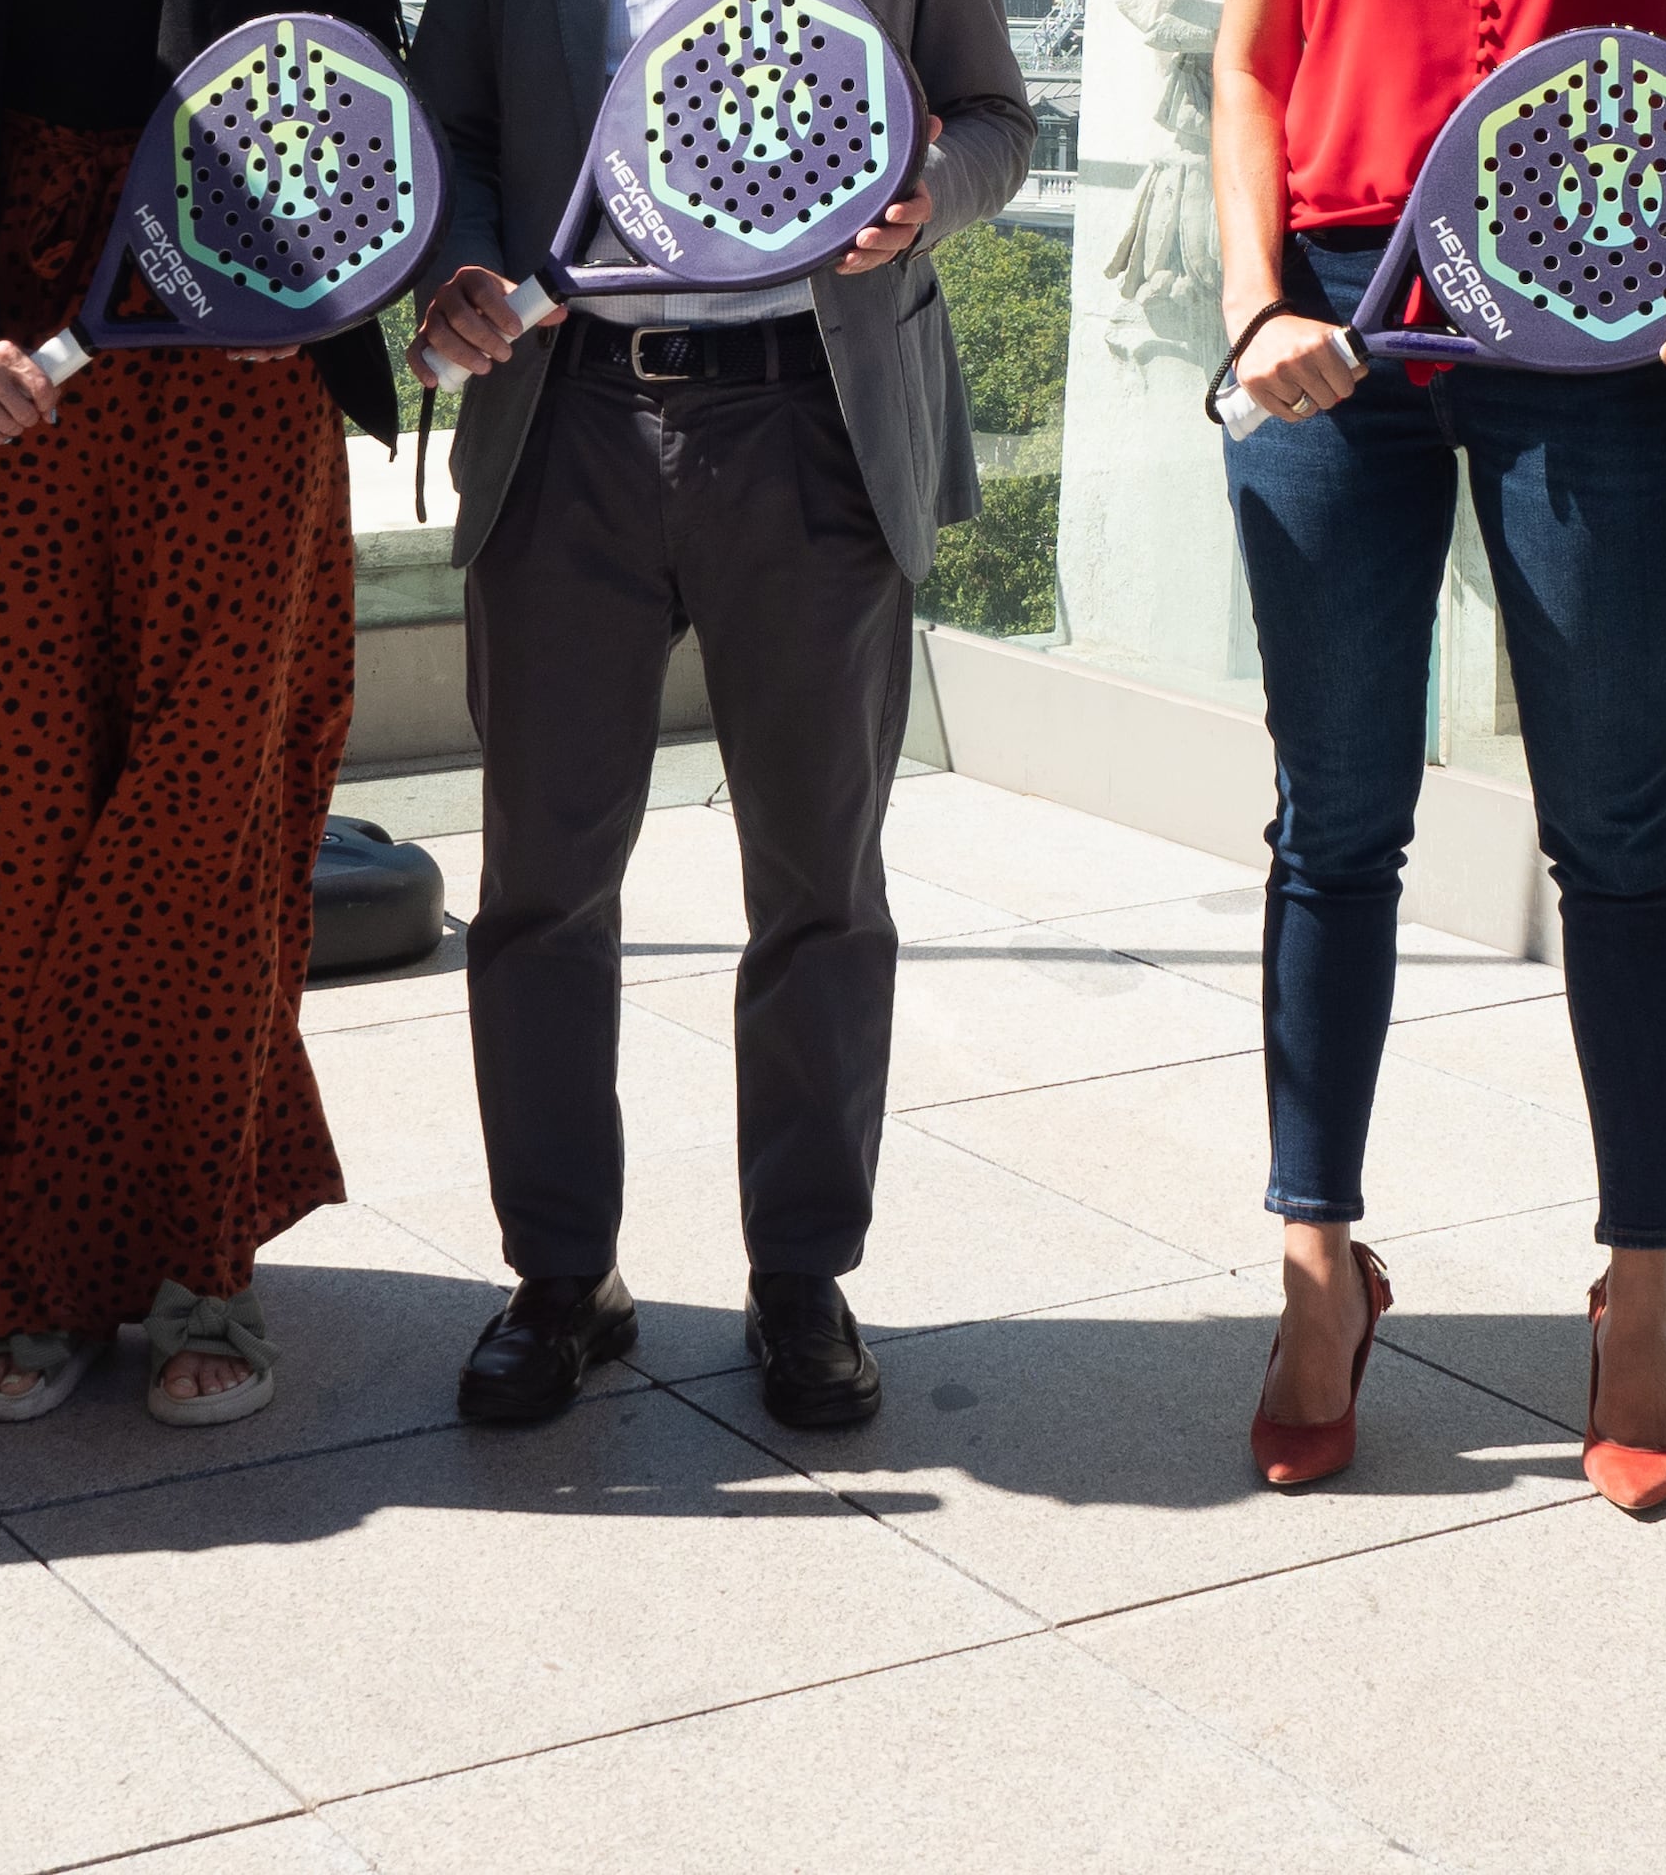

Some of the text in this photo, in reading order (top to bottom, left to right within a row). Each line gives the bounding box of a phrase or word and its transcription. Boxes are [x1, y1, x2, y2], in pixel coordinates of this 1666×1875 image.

[604, 149, 684, 262] HEXAGON
[609, 193, 647, 239] CUP
[134, 204, 213, 318] HEXAGON
[139, 248, 176, 294] CUP
[1429, 215, 1513, 341] HEXAGON
[1432, 262, 1473, 314] CUP
